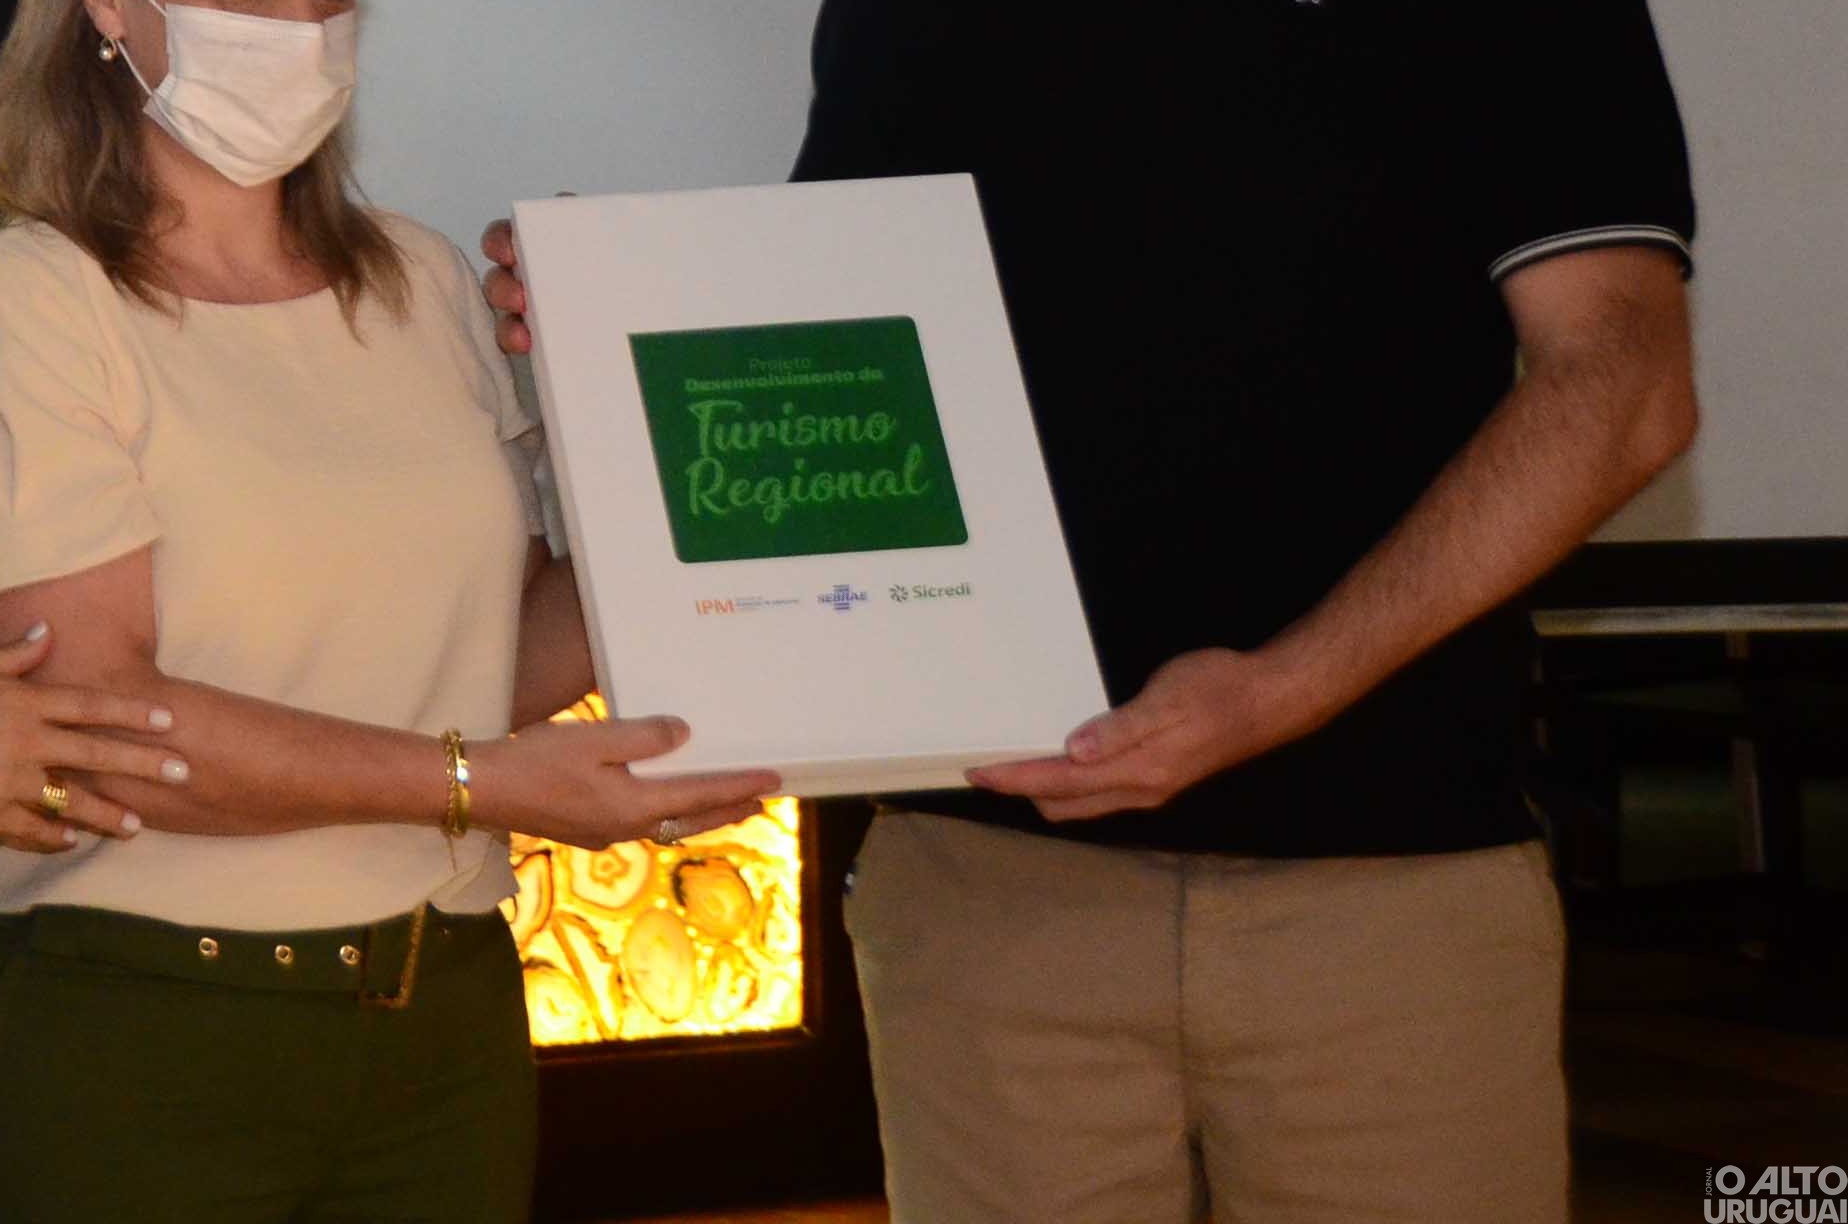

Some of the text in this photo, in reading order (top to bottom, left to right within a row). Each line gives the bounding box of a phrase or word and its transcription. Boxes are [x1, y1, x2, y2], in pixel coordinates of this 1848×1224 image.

[688, 399, 896, 458] Turismo
[684, 442, 929, 524] Regional
[695, 599, 736, 617] IPM
[912, 583, 970, 600] Sicredi
